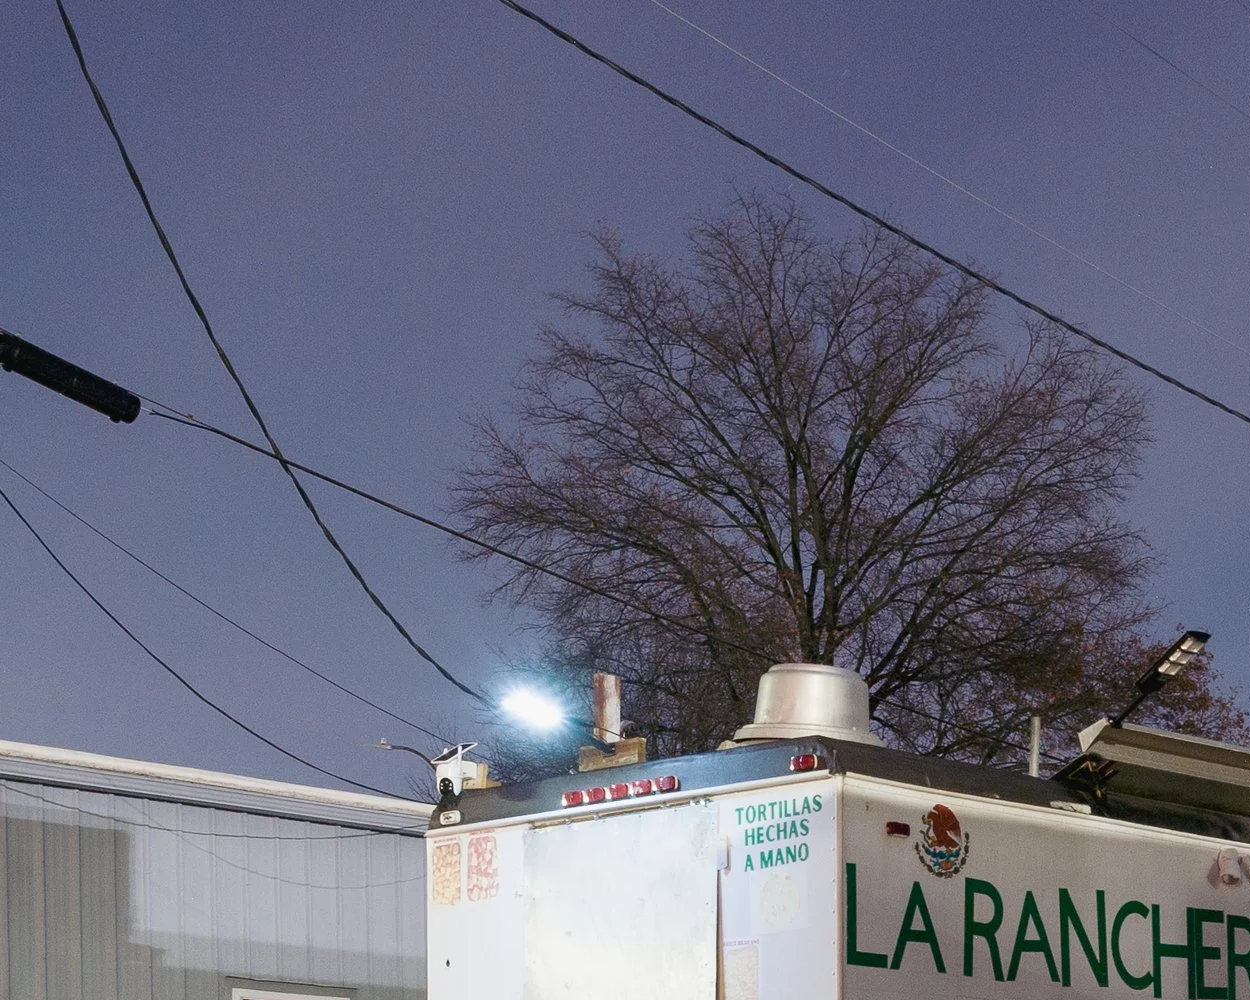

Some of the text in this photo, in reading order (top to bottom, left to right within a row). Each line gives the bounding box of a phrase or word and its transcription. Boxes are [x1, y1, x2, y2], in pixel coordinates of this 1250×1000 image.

[735, 794, 823, 826] TORTILLAS
[744, 818, 810, 847] HECHAS
[744, 842, 809, 873] A MANO
[846, 862, 948, 974] LA
